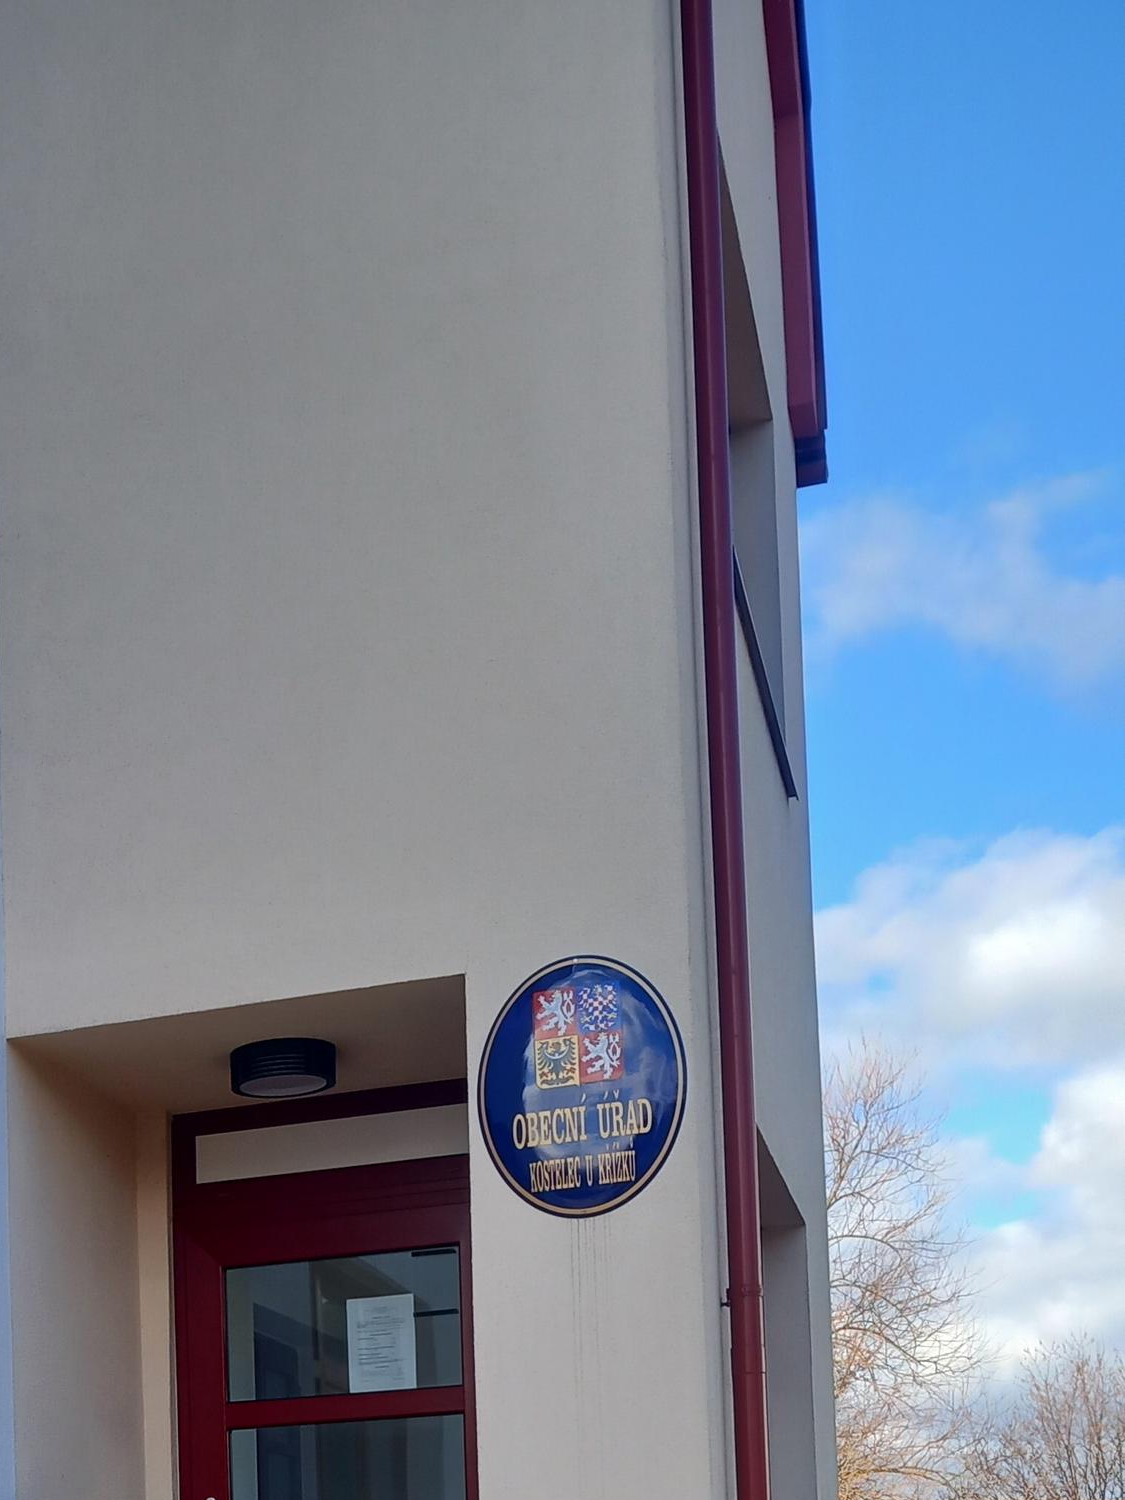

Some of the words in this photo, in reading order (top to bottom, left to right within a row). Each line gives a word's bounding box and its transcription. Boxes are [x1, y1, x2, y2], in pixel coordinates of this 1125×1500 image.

[512, 1093, 587, 1150] OBECNÍ
[596, 1089, 652, 1139] ÚŘAD
[529, 1156, 581, 1193] KOSTELEC
[585, 1155, 593, 1186] U
